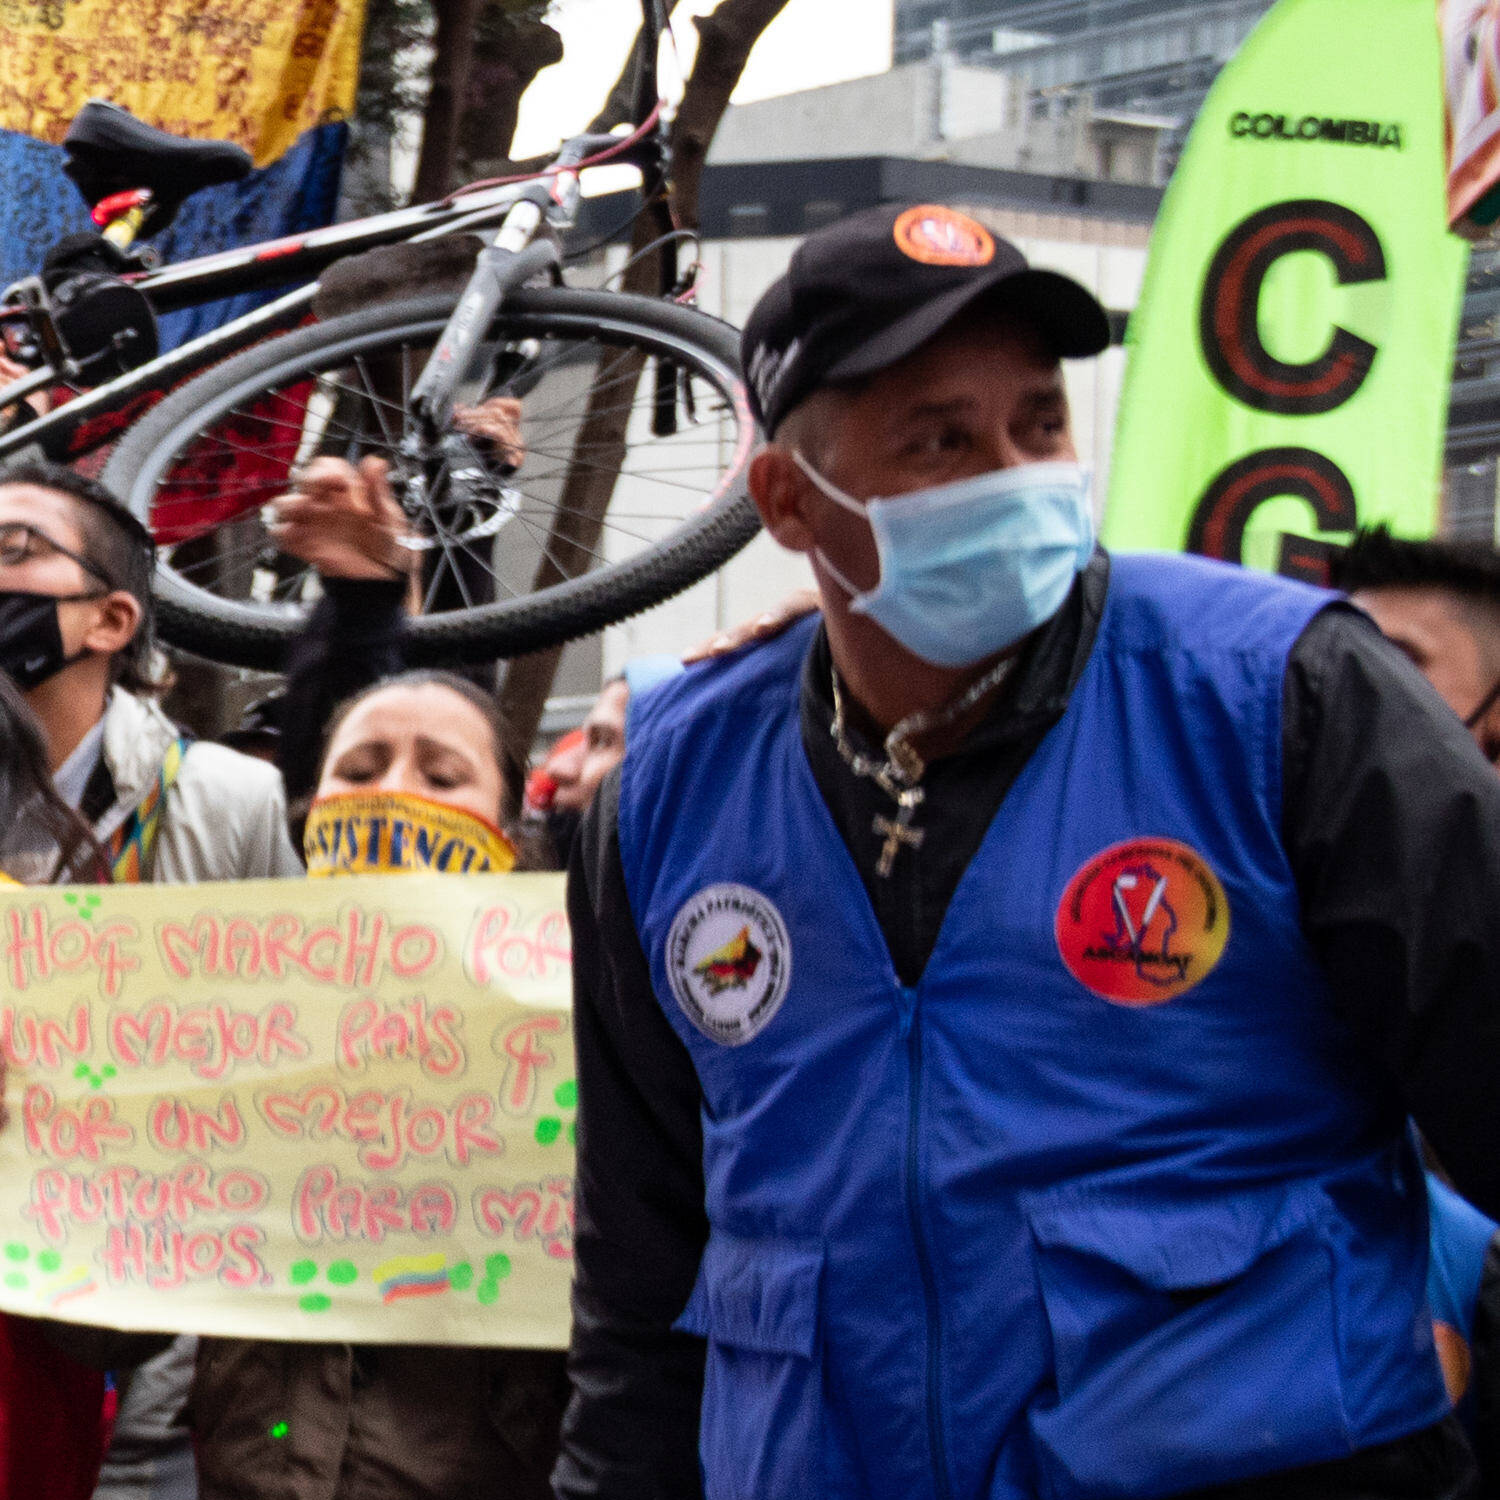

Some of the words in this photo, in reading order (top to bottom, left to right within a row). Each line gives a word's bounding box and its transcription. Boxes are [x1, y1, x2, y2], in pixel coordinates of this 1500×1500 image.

[1229, 111, 1404, 151] COLOMBIA
[158, 908, 440, 987] MARCHO
[466, 902, 573, 985] POR
[0, 1003, 91, 1068] UN
[109, 1001, 309, 1080] MEJOR
[21, 1082, 133, 1163] POR
[260, 1084, 502, 1172] MEJOR
[297, 1163, 456, 1243] PARA
